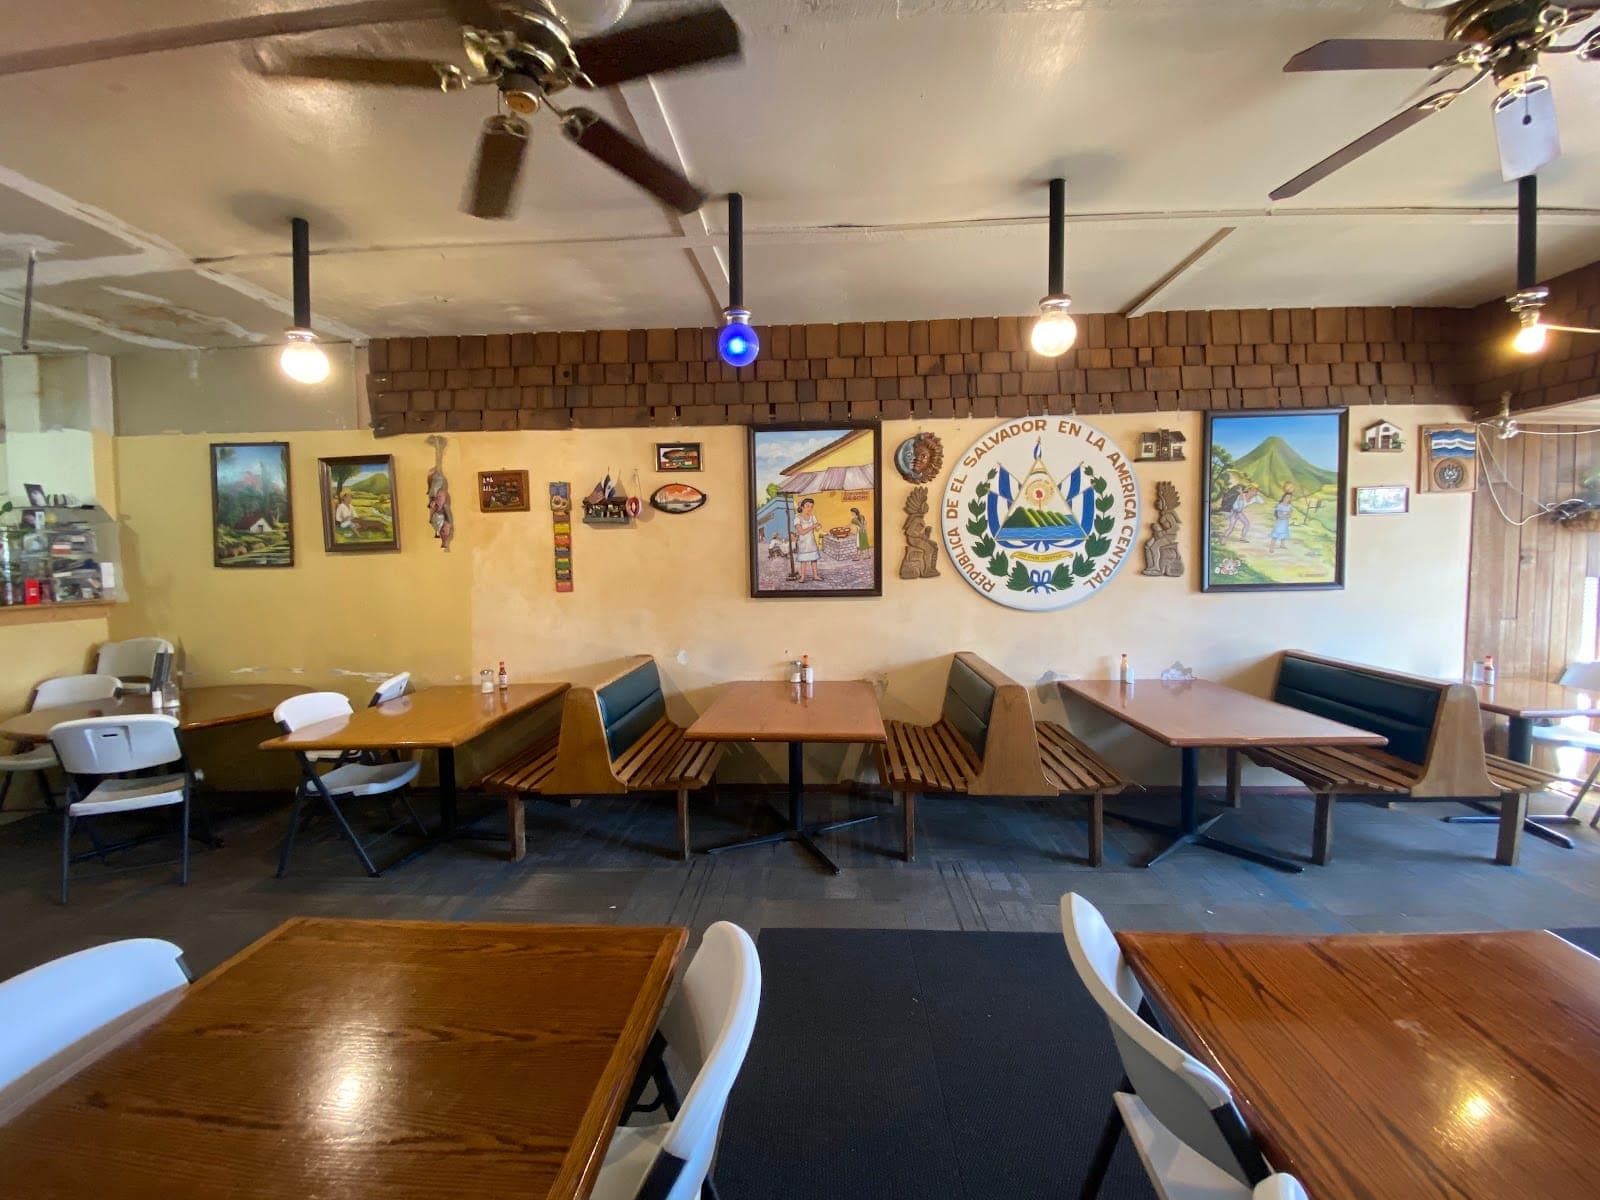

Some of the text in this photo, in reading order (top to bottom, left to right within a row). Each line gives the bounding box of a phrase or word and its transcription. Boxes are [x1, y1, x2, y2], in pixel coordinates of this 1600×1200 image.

[946, 419, 1137, 593] REPUBLICA DE EL SALVADOR EN LA AMERICA CENTRAL
